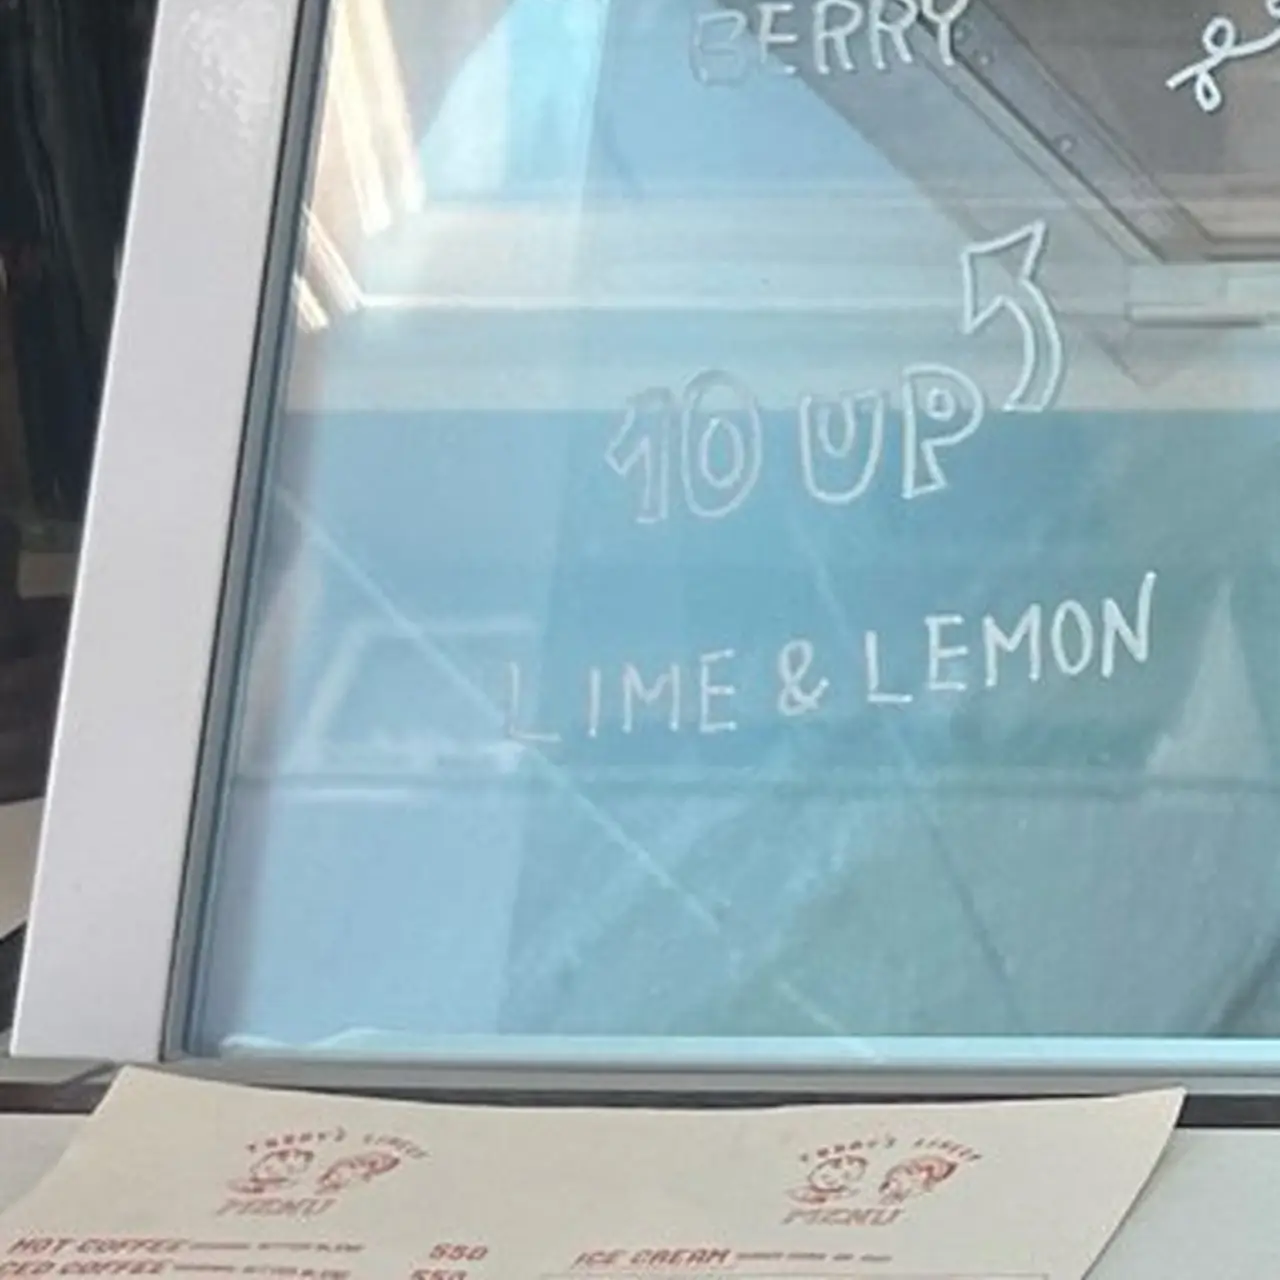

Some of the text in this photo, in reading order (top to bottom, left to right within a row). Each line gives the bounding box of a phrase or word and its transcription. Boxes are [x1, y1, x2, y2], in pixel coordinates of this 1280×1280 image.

[507, 571, 1156, 743] LIME & LEMON
